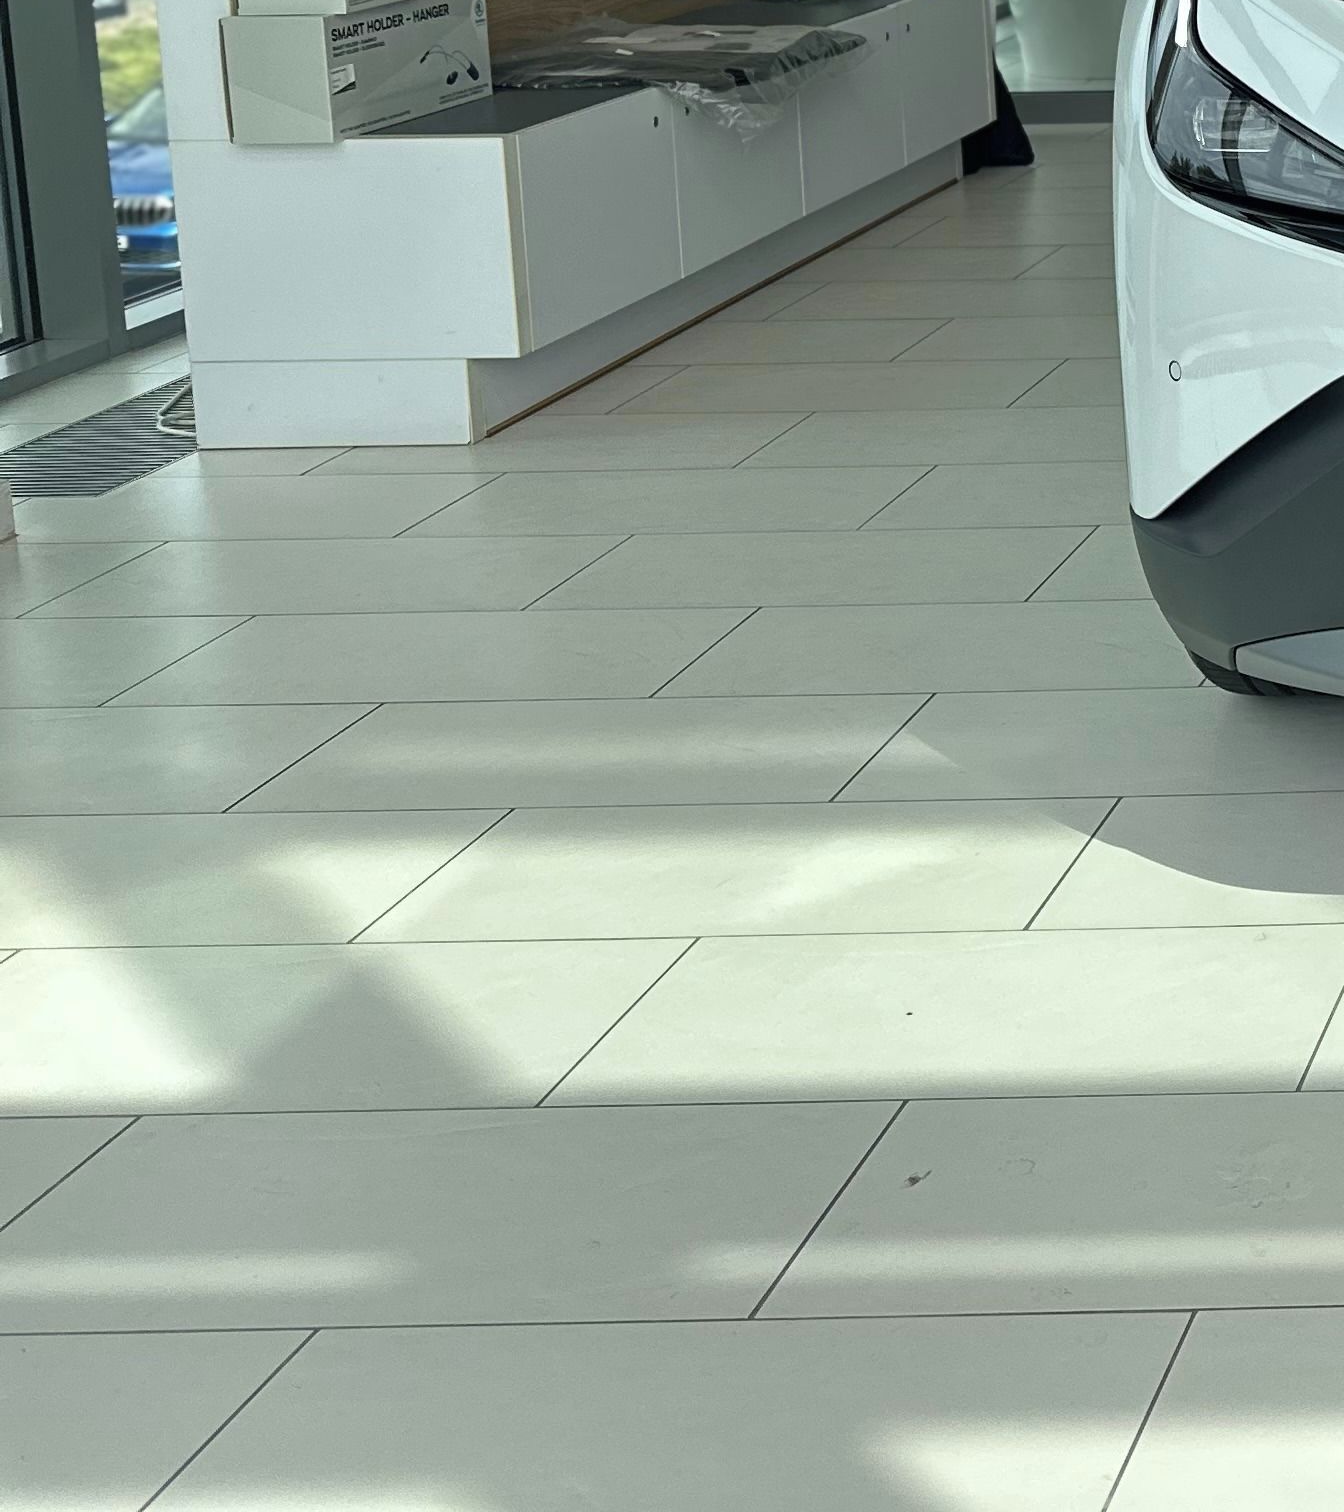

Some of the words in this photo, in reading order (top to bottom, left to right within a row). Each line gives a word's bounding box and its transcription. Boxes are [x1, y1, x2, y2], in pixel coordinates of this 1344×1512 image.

[331, 22, 365, 42] SMART
[367, 13, 405, 34] HOLDER
[412, 3, 450, 24] HANGER
